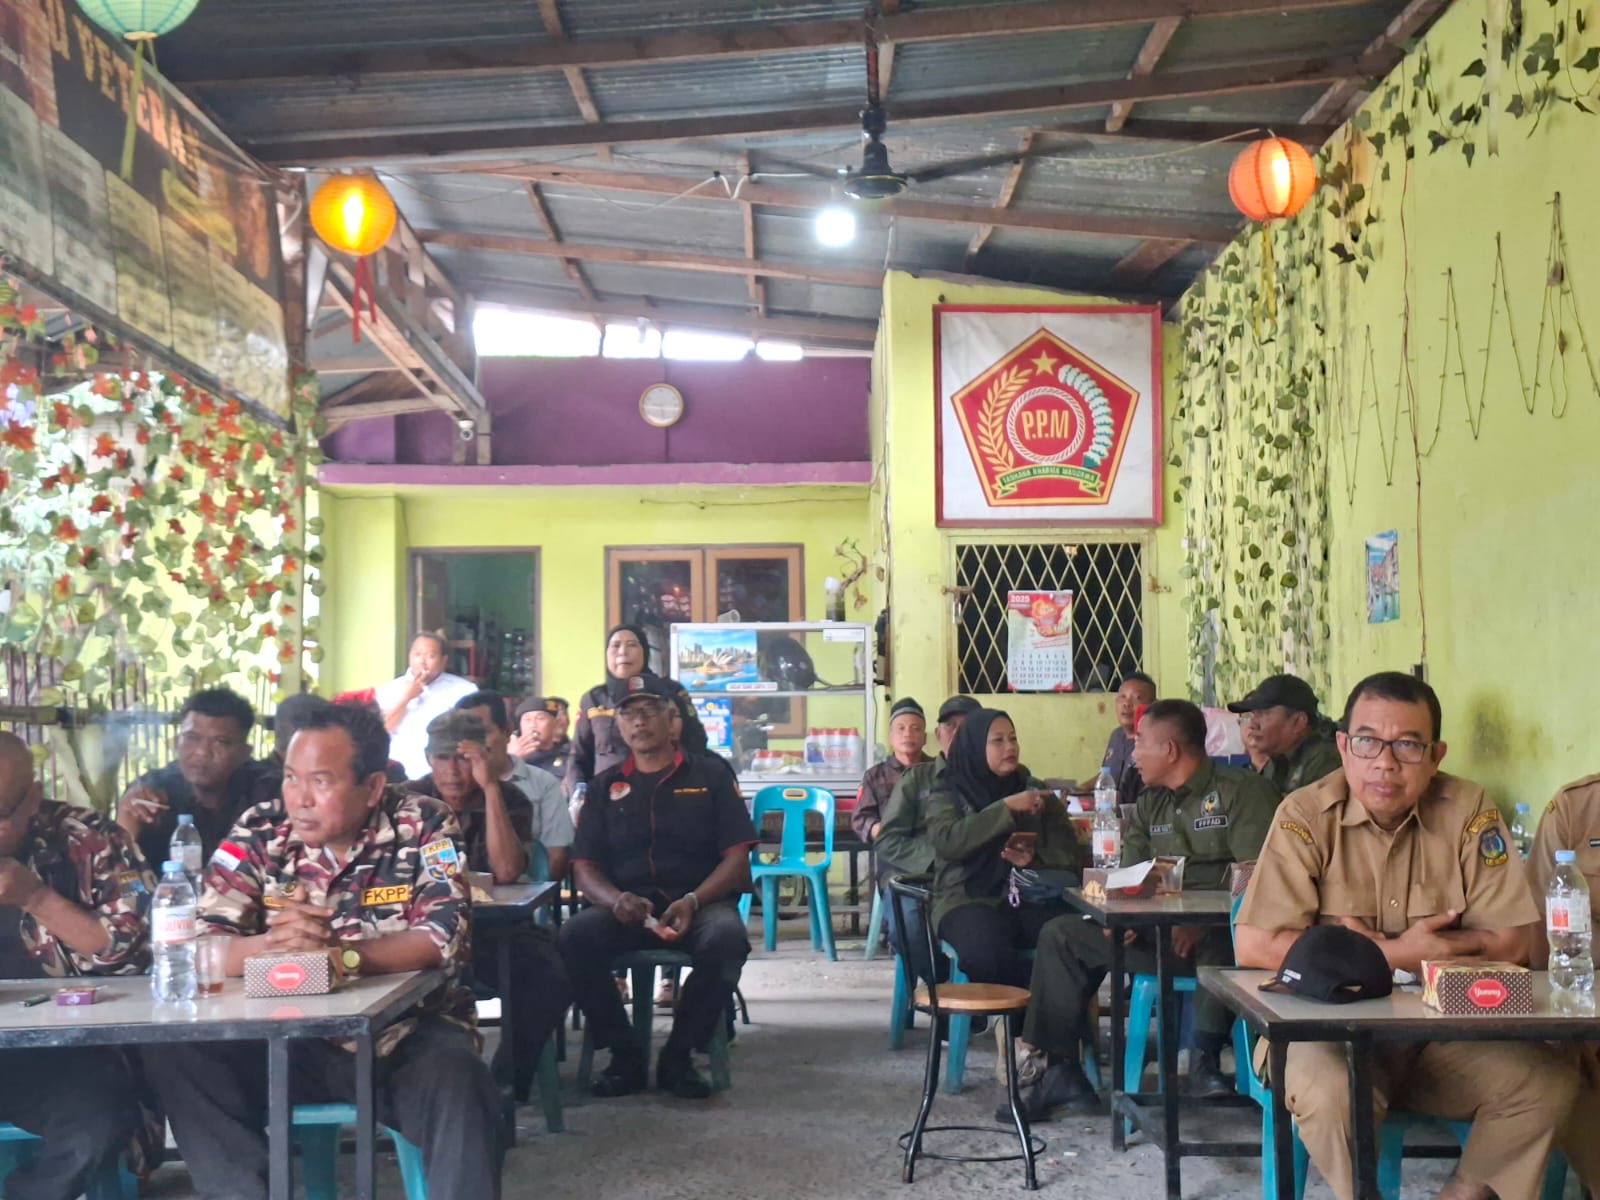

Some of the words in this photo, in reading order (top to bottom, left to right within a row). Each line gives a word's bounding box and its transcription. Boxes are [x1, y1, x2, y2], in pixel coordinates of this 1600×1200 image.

[1021, 408, 1069, 440] P.P.M
[1010, 595, 1031, 603] 2025
[363, 887, 407, 904] FKPP
[1474, 986, 1501, 999] Yummy
